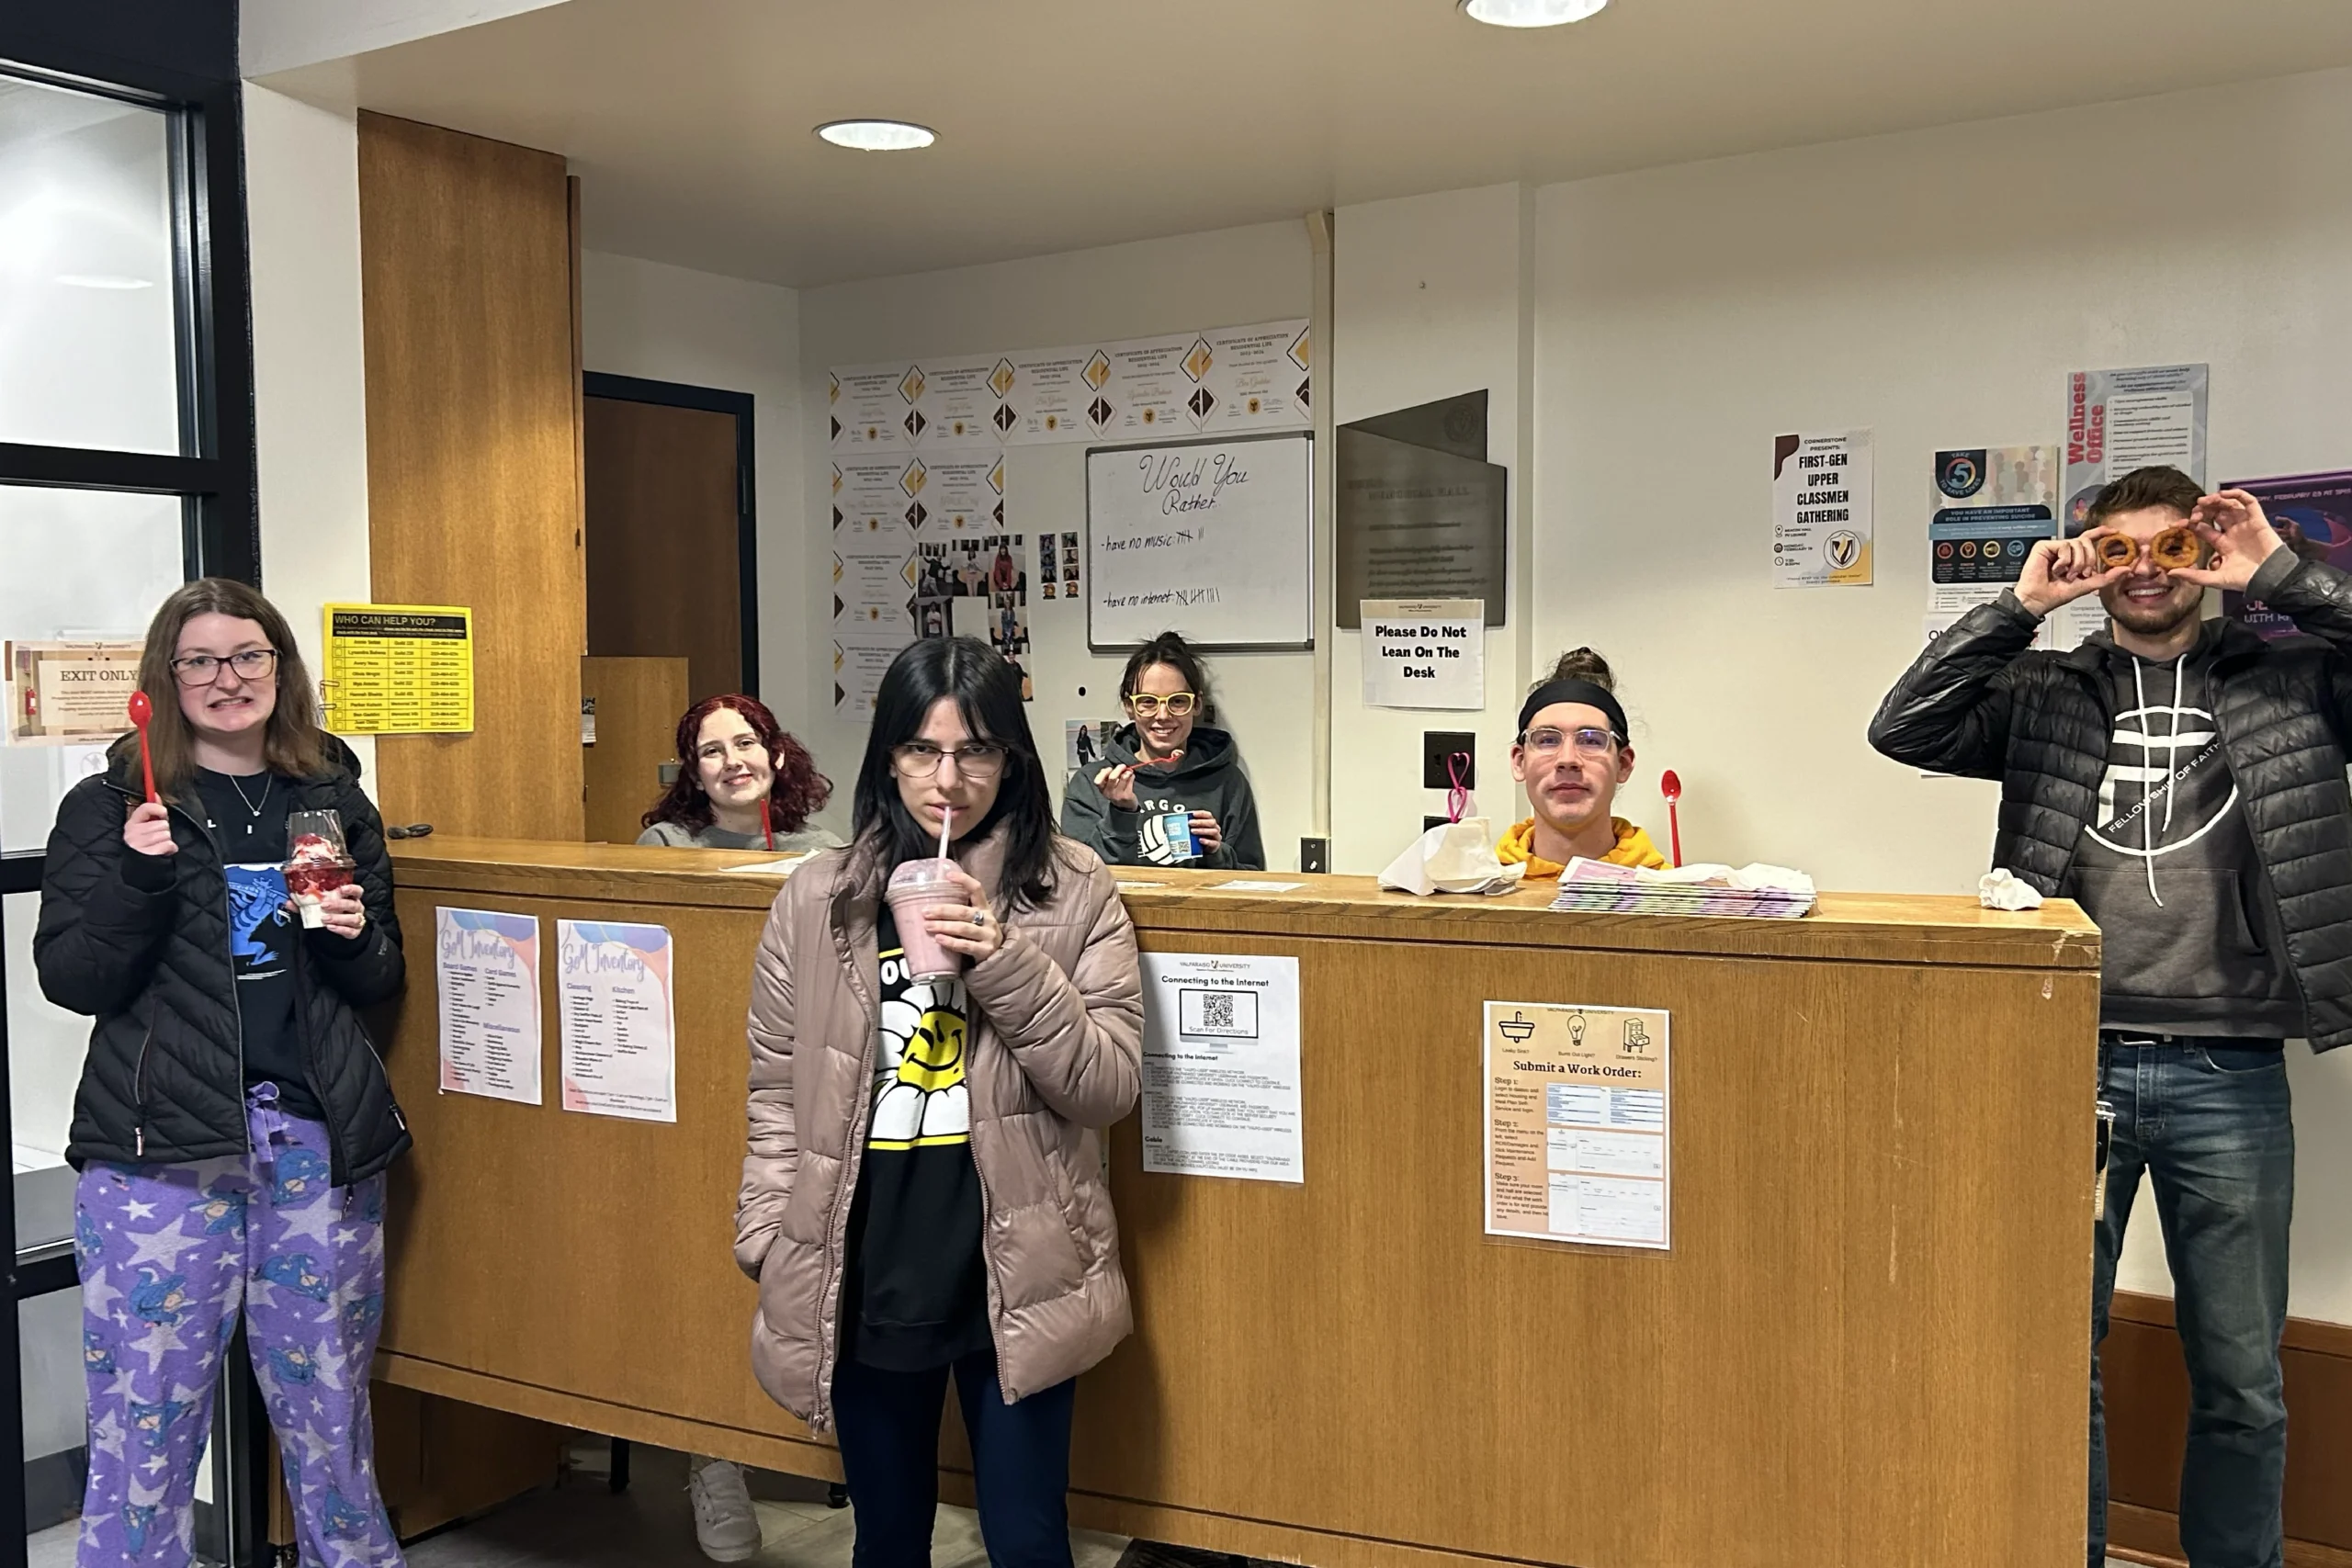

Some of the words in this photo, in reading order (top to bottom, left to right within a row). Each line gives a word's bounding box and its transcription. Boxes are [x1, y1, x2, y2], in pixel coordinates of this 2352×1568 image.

[1216, 338, 1246, 346] CERTIFICATE
[1254, 333, 1289, 342] APPRECIATION
[2067, 372, 2086, 465] Wellness
[1804, 436, 1847, 445] CORNERSTONE
[2086, 404, 2104, 464] Office
[1798, 453, 1848, 469] FIRST-GEN
[1139, 454, 1208, 493] Would
[1213, 453, 1250, 496] You
[1807, 472, 1838, 487] UPPER
[1951, 463, 1971, 487] 5
[1939, 479, 1948, 489] TO
[1947, 486, 1964, 495] SAVE
[1965, 478, 1982, 493] LIVES
[1796, 490, 1849, 506] CLASSMEN
[1796, 508, 1849, 525] GATHERING
[1128, 536, 1142, 550] no
[1127, 594, 1139, 606] no
[334, 615, 358, 625] WHO
[360, 615, 381, 625] CAN
[383, 616, 408, 626] HELP
[410, 617, 436, 626] YOU?
[2244, 613, 2274, 624] WITH
[1374, 625, 1418, 638] Please
[1419, 626, 1438, 638] Do
[1441, 626, 1467, 638] Not
[1381, 645, 1411, 659] Lean
[1414, 646, 1433, 659] On
[1435, 646, 1460, 659] The
[60, 671, 97, 682] EXIT
[99, 671, 139, 682] ONLY
[1402, 666, 1436, 679] Desk
[2175, 764, 2191, 781] OF
[2190, 741, 2221, 768] FAITH
[1139, 799, 1186, 814] RGO
[468, 930, 514, 969] Inventory
[459, 964, 478, 972] Games
[592, 943, 645, 982] Inventory
[484, 967, 497, 976] Card
[498, 969, 517, 978] Games
[566, 982, 593, 993] Cleaning
[1161, 976, 1209, 987] Connecting
[1236, 978, 1270, 987] Internet
[1143, 1051, 1176, 1061] Connecting
[1512, 1060, 1555, 1073] Submit
[1566, 1064, 1600, 1076] Work
[1602, 1067, 1642, 1078] Order:
[1494, 1077, 1512, 1086] Step
[1494, 1118, 1512, 1128] Step
[1494, 1172, 1512, 1181] Step
